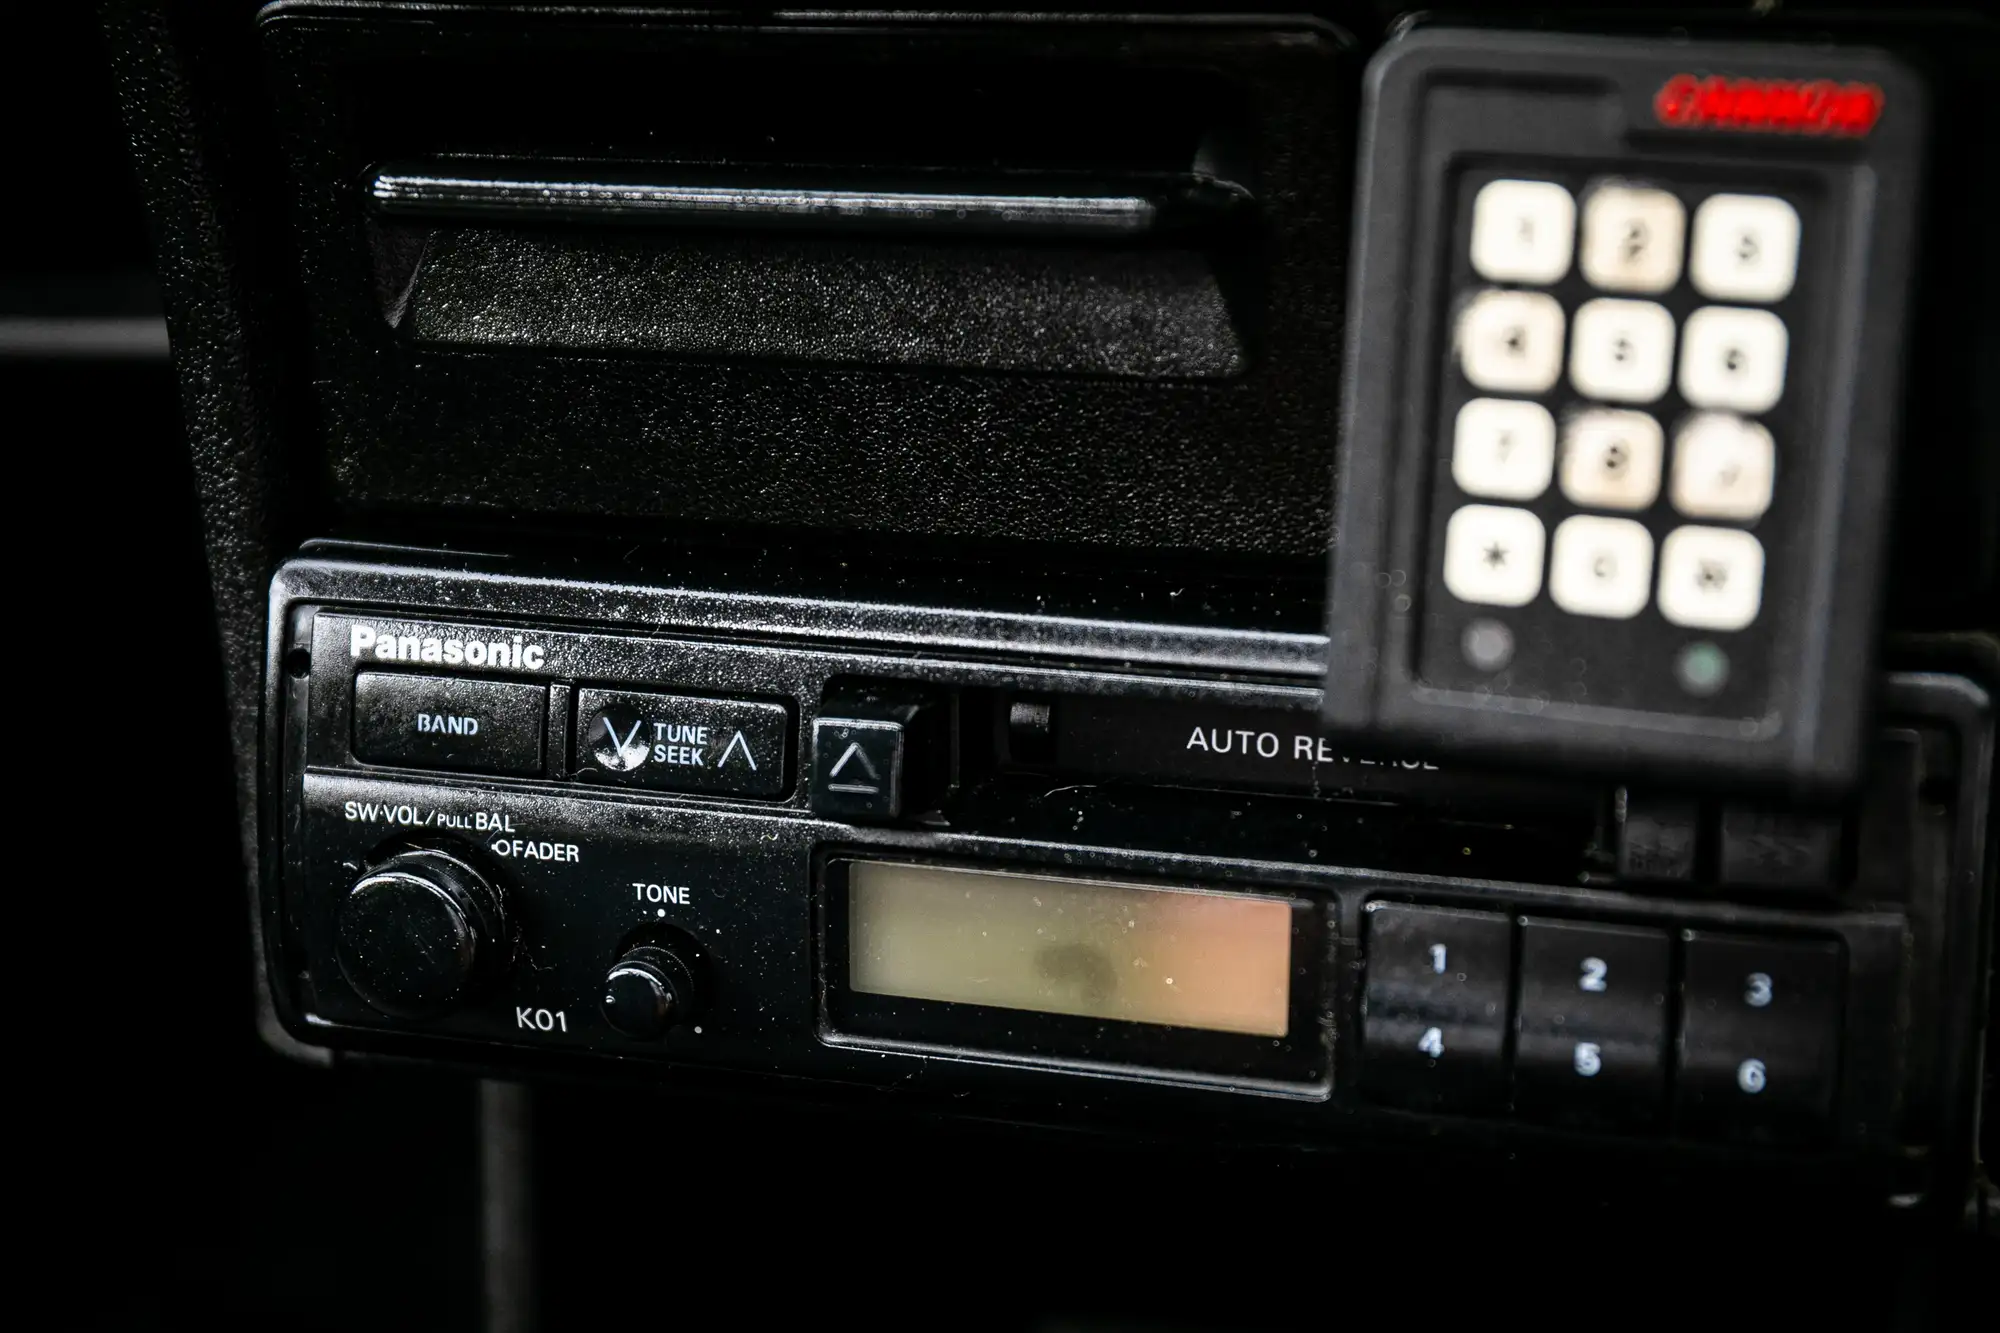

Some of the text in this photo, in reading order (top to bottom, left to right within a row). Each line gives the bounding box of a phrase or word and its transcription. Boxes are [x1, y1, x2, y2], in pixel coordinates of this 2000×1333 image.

[350, 625, 545, 670] Panasonic
[417, 713, 479, 736] BAND
[653, 722, 708, 746] TUNE
[1186, 726, 1279, 758] AUTO
[653, 744, 704, 767] SEEK
[475, 811, 516, 833] BAL
[512, 839, 580, 863] FADER
[631, 882, 691, 905] TONE
[1429, 943, 1772, 1008] 1 2 3
[1418, 1026, 1767, 1094] 4 5 6
